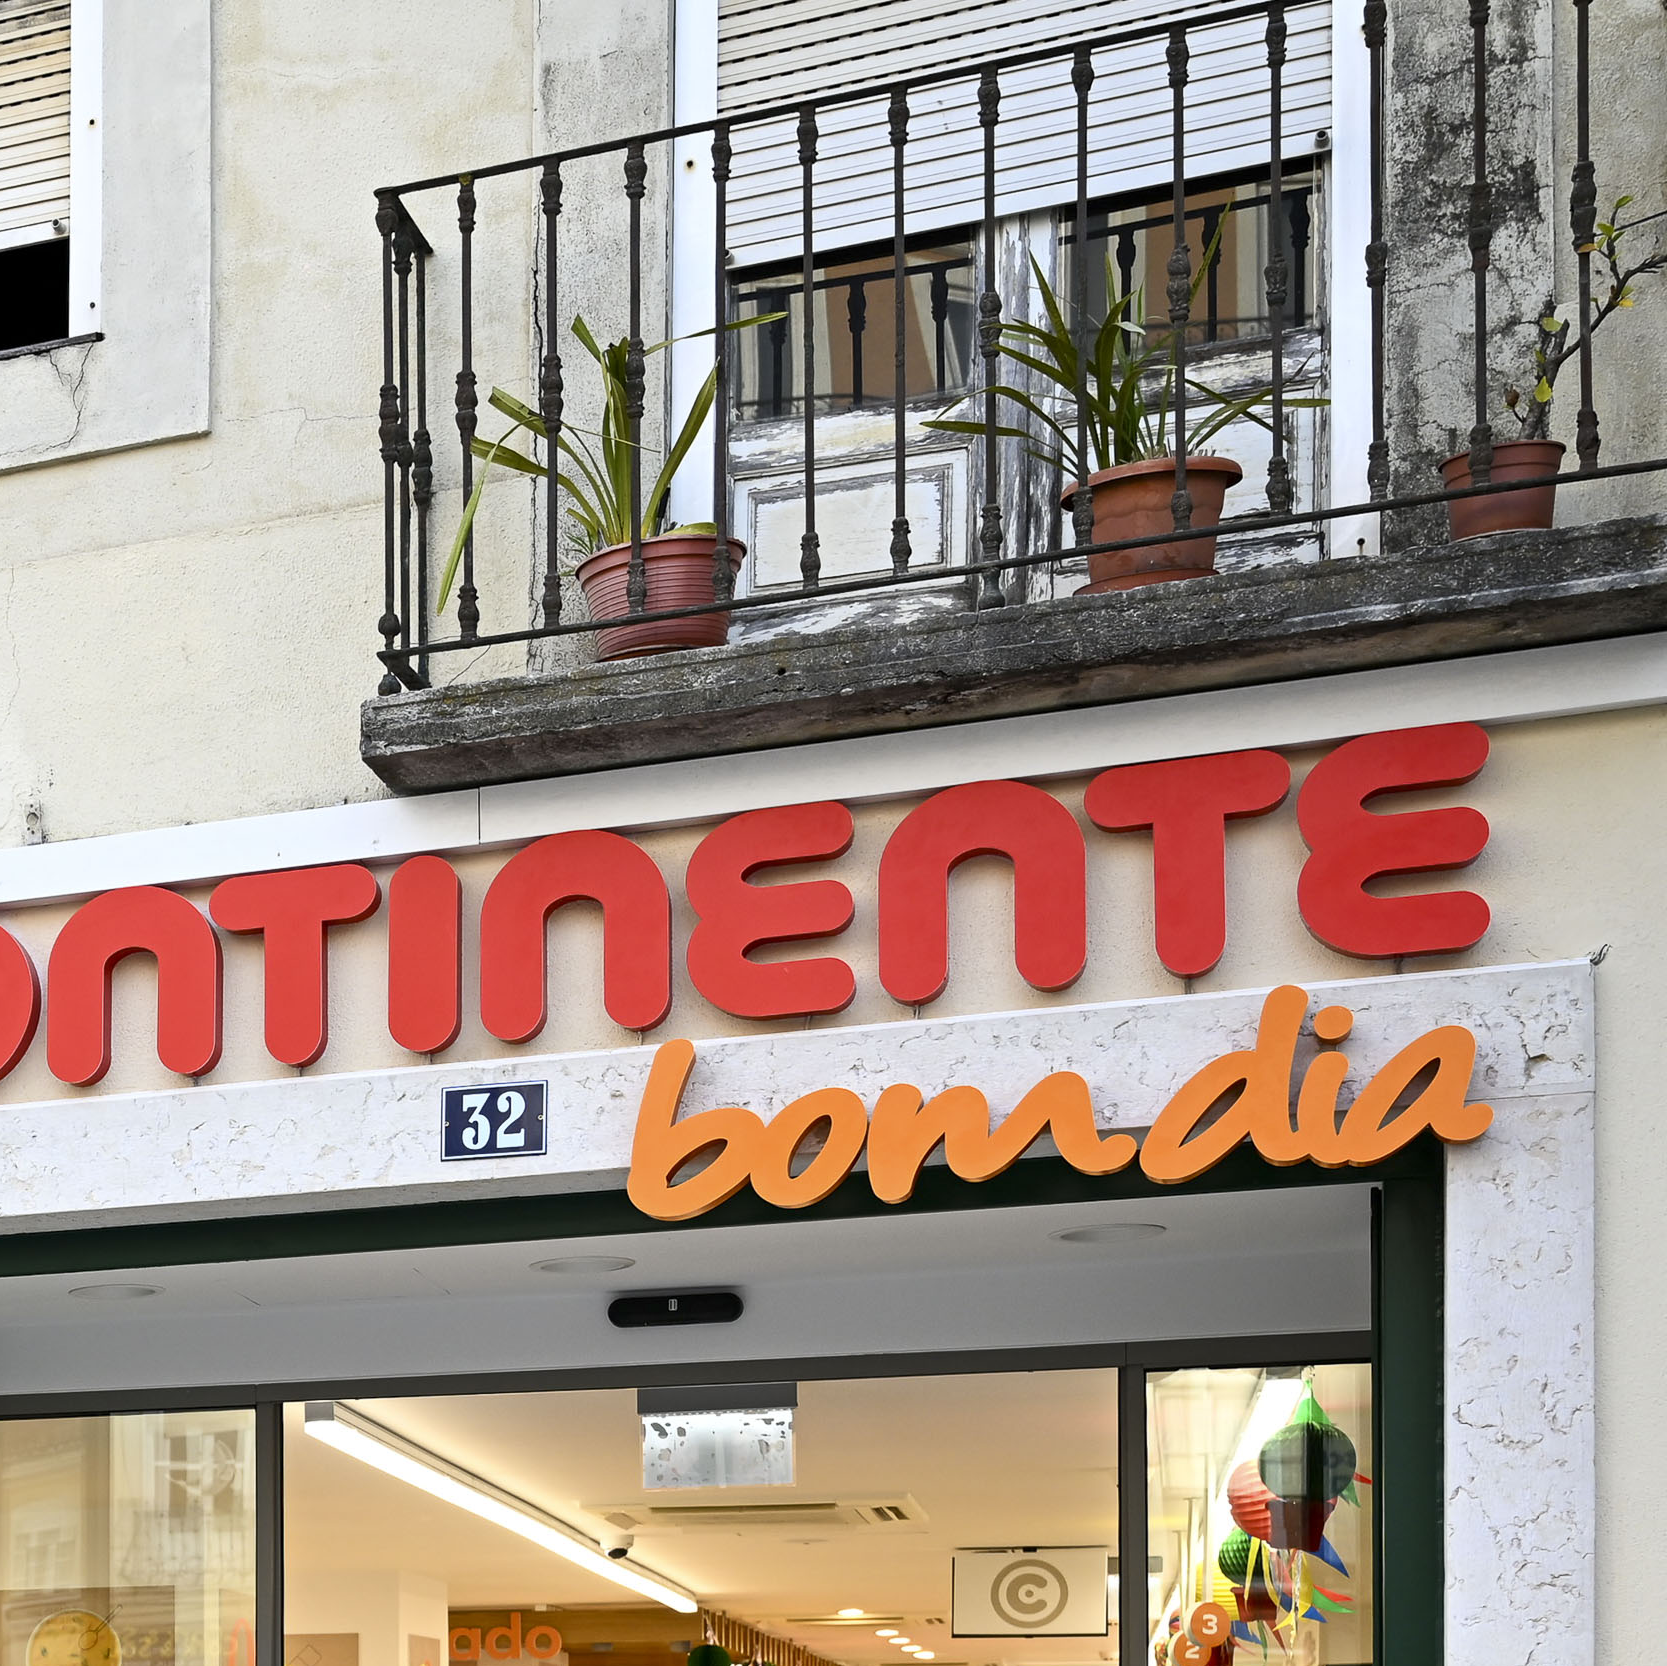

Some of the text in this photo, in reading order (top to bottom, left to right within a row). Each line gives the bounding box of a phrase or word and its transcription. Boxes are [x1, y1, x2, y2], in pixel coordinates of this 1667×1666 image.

[461, 1090, 526, 1151] 32
[627, 983, 1496, 1222] bom dia
[1201, 1613, 1219, 1635] 3
[1184, 1641, 1200, 1660] 2
